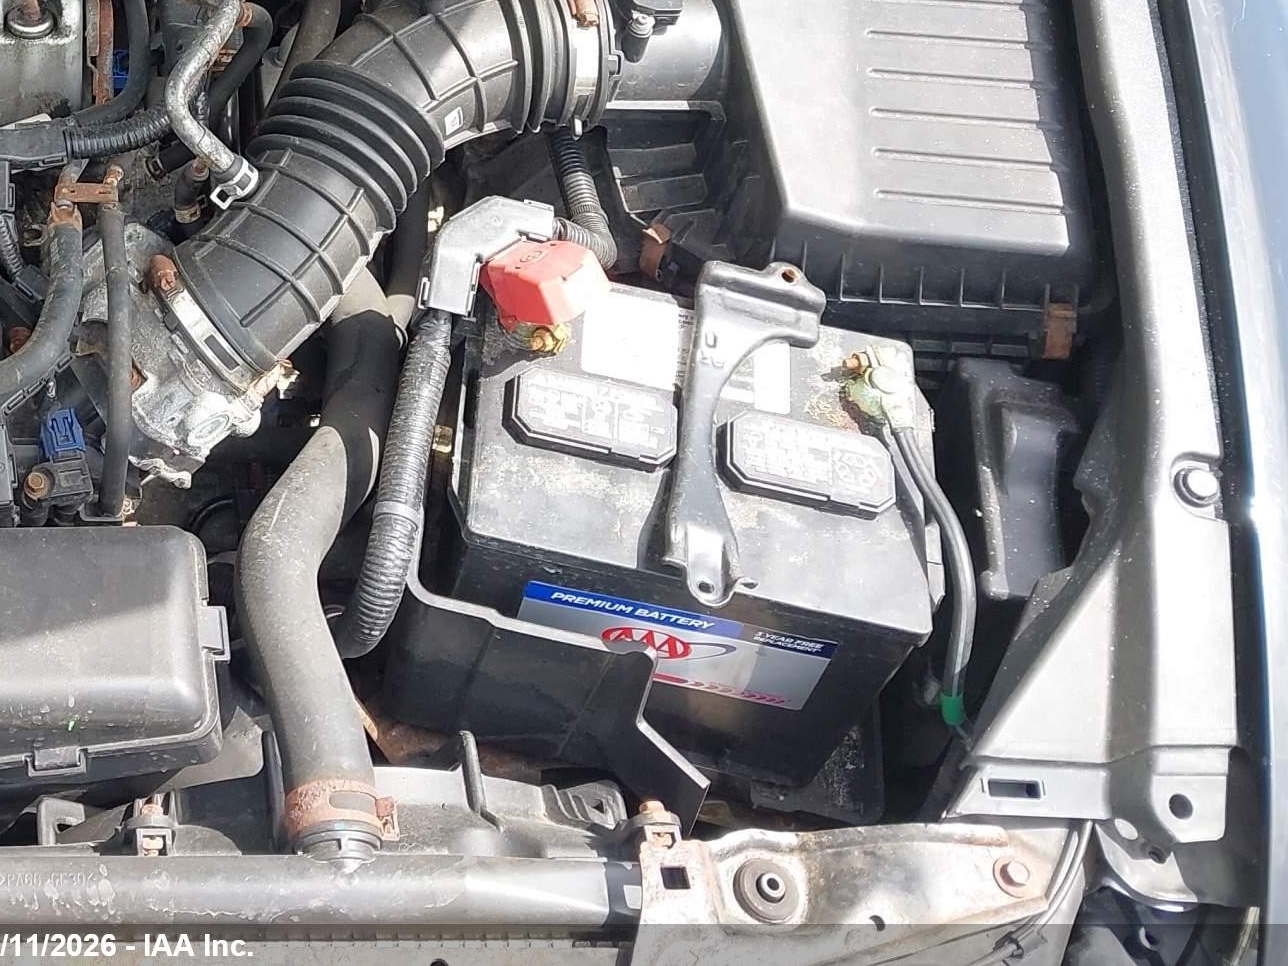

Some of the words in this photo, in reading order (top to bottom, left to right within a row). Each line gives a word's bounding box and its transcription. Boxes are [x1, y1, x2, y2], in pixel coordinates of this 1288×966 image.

[550, 591, 633, 615] PREMIUM
[634, 607, 715, 630] BATTERY
[766, 633, 794, 643] YEAR
[794, 640, 824, 649] FREE
